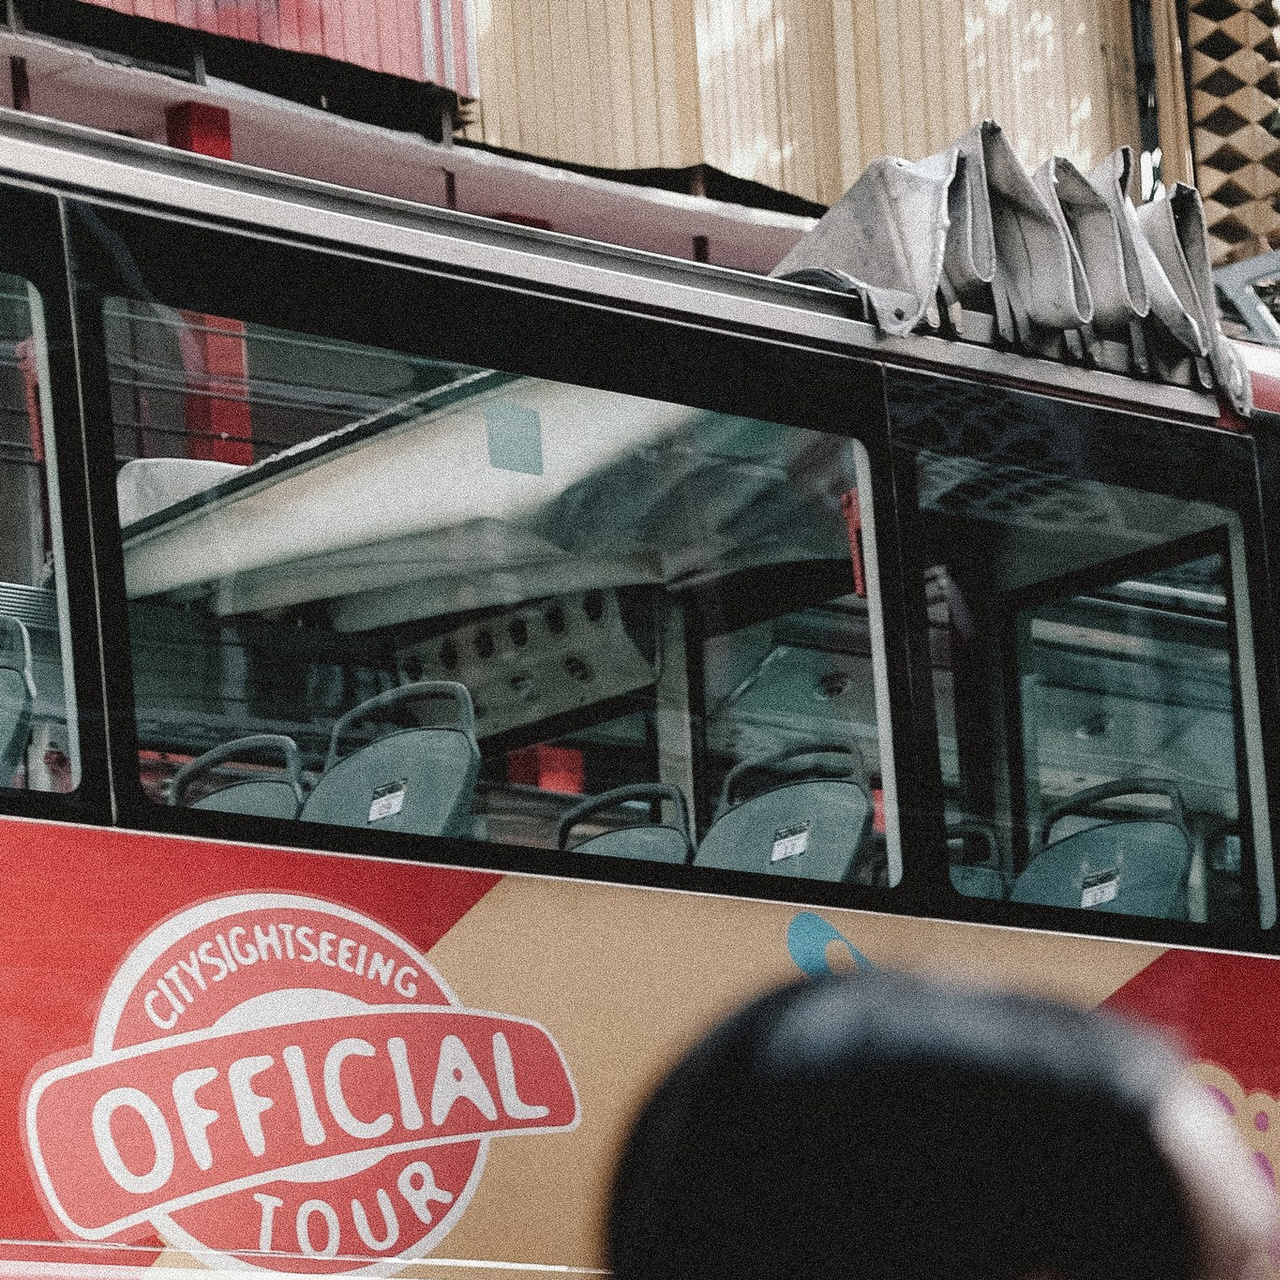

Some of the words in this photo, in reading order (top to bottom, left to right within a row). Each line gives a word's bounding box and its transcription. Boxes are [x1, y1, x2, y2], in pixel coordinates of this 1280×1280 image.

[143, 923, 418, 1031] CITYSIGHTSEEING
[91, 1031, 551, 1195] OFFICIAL
[252, 1160, 453, 1259] TOUR
